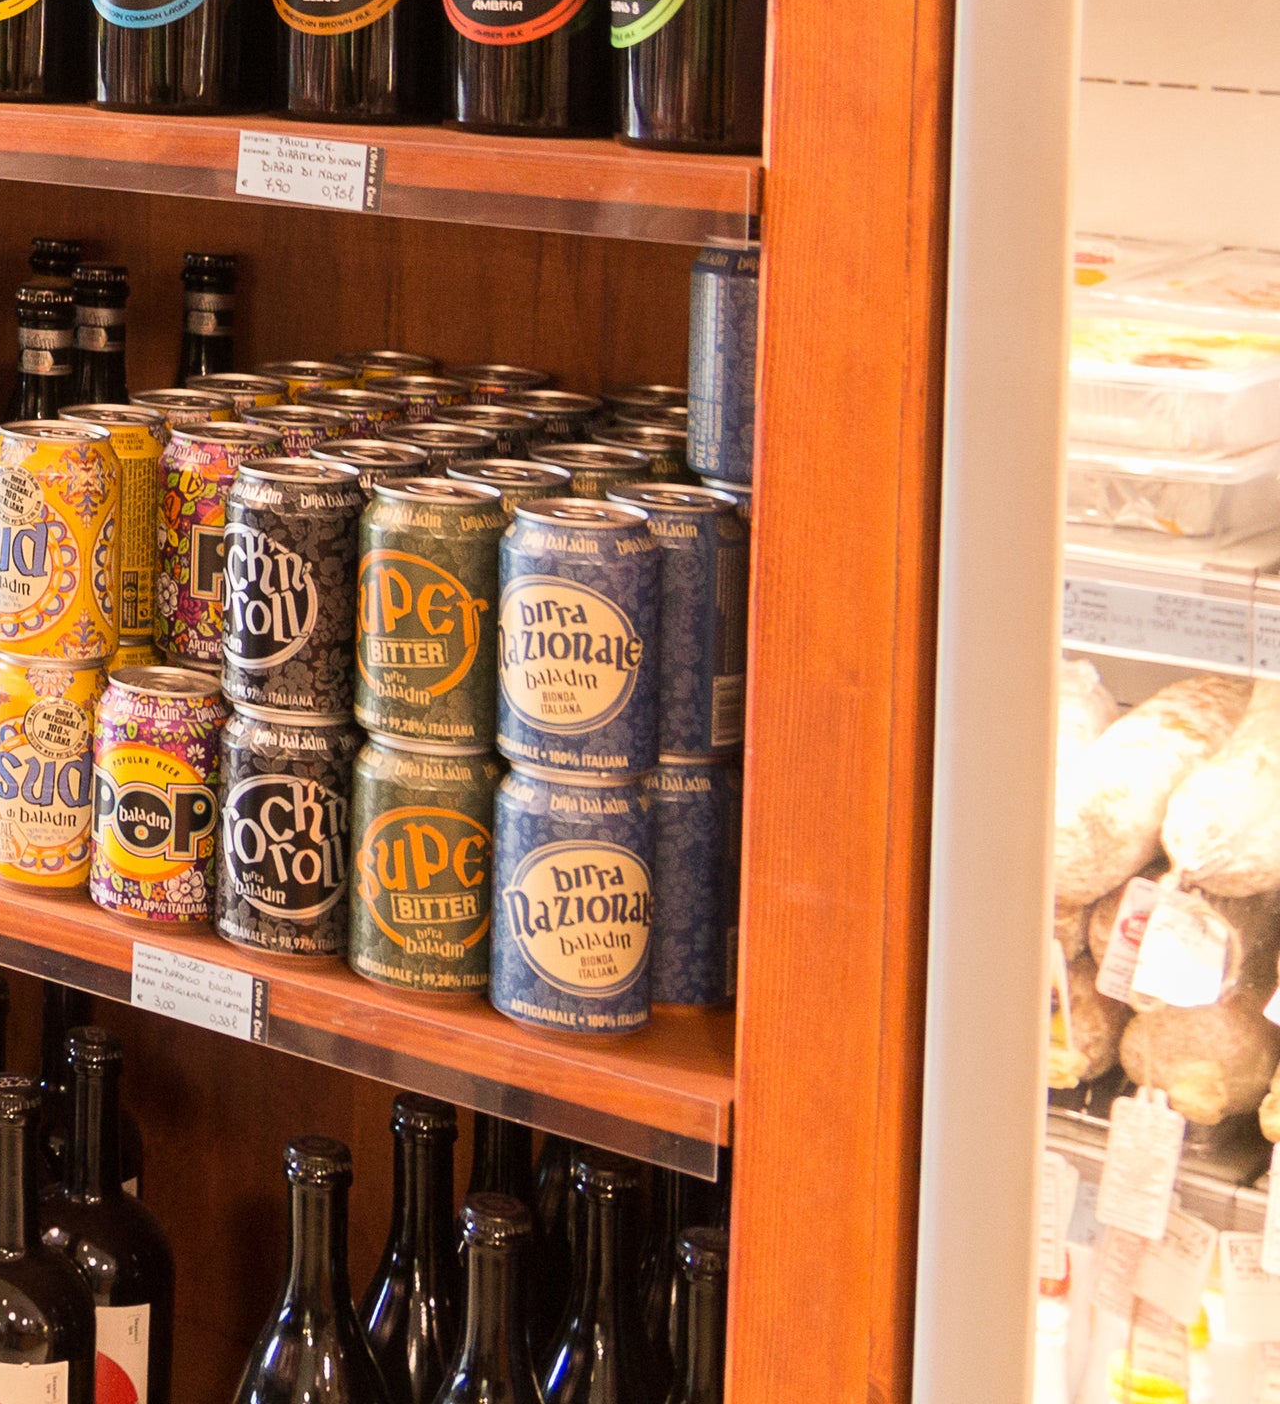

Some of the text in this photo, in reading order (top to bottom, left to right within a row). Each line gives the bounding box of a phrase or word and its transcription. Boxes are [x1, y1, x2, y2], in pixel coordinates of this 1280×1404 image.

[472, 0, 523, 11] AMBRIA
[277, 147, 325, 163] BIRRIFICIO
[261, 160, 347, 182] BIRRA DI NAON
[175, 446, 211, 465] baladin
[242, 484, 282, 505] baladin
[400, 508, 442, 529] baladin
[549, 532, 598, 554] baladin
[521, 600, 587, 626] birra
[371, 641, 444, 664] BITTER
[384, 670, 407, 684] birra
[526, 670, 597, 690] baladin
[268, 694, 313, 707] ITALIANA
[376, 681, 431, 706] baladin
[542, 692, 575, 702] BIONDA
[136, 703, 180, 721] baladin
[541, 704, 582, 715] ITALIANA
[39, 731, 71, 746] ITALIANA
[428, 721, 475, 737] ITALIANA
[280, 732, 327, 750] baladin
[113, 756, 180, 778] POPULAR BEER
[549, 749, 629, 768] 100% ITALIANA
[422, 761, 471, 781] baladin
[662, 773, 711, 792] baladin
[580, 795, 629, 815] baladin
[7, 807, 77, 827] di baladin
[119, 805, 169, 830] baladin
[243, 871, 264, 884] birra
[551, 864, 624, 892] birra
[235, 879, 286, 904] baladin
[168, 898, 207, 914] ITALIANA
[399, 894, 477, 920] BITTER
[416, 927, 442, 940] birra
[405, 935, 464, 958] baladin
[560, 932, 631, 956] baladin
[581, 955, 613, 966] BIONDA
[579, 966, 619, 979] ITALIANA
[512, 1000, 616, 1028] ARTIGIANALE 100%
